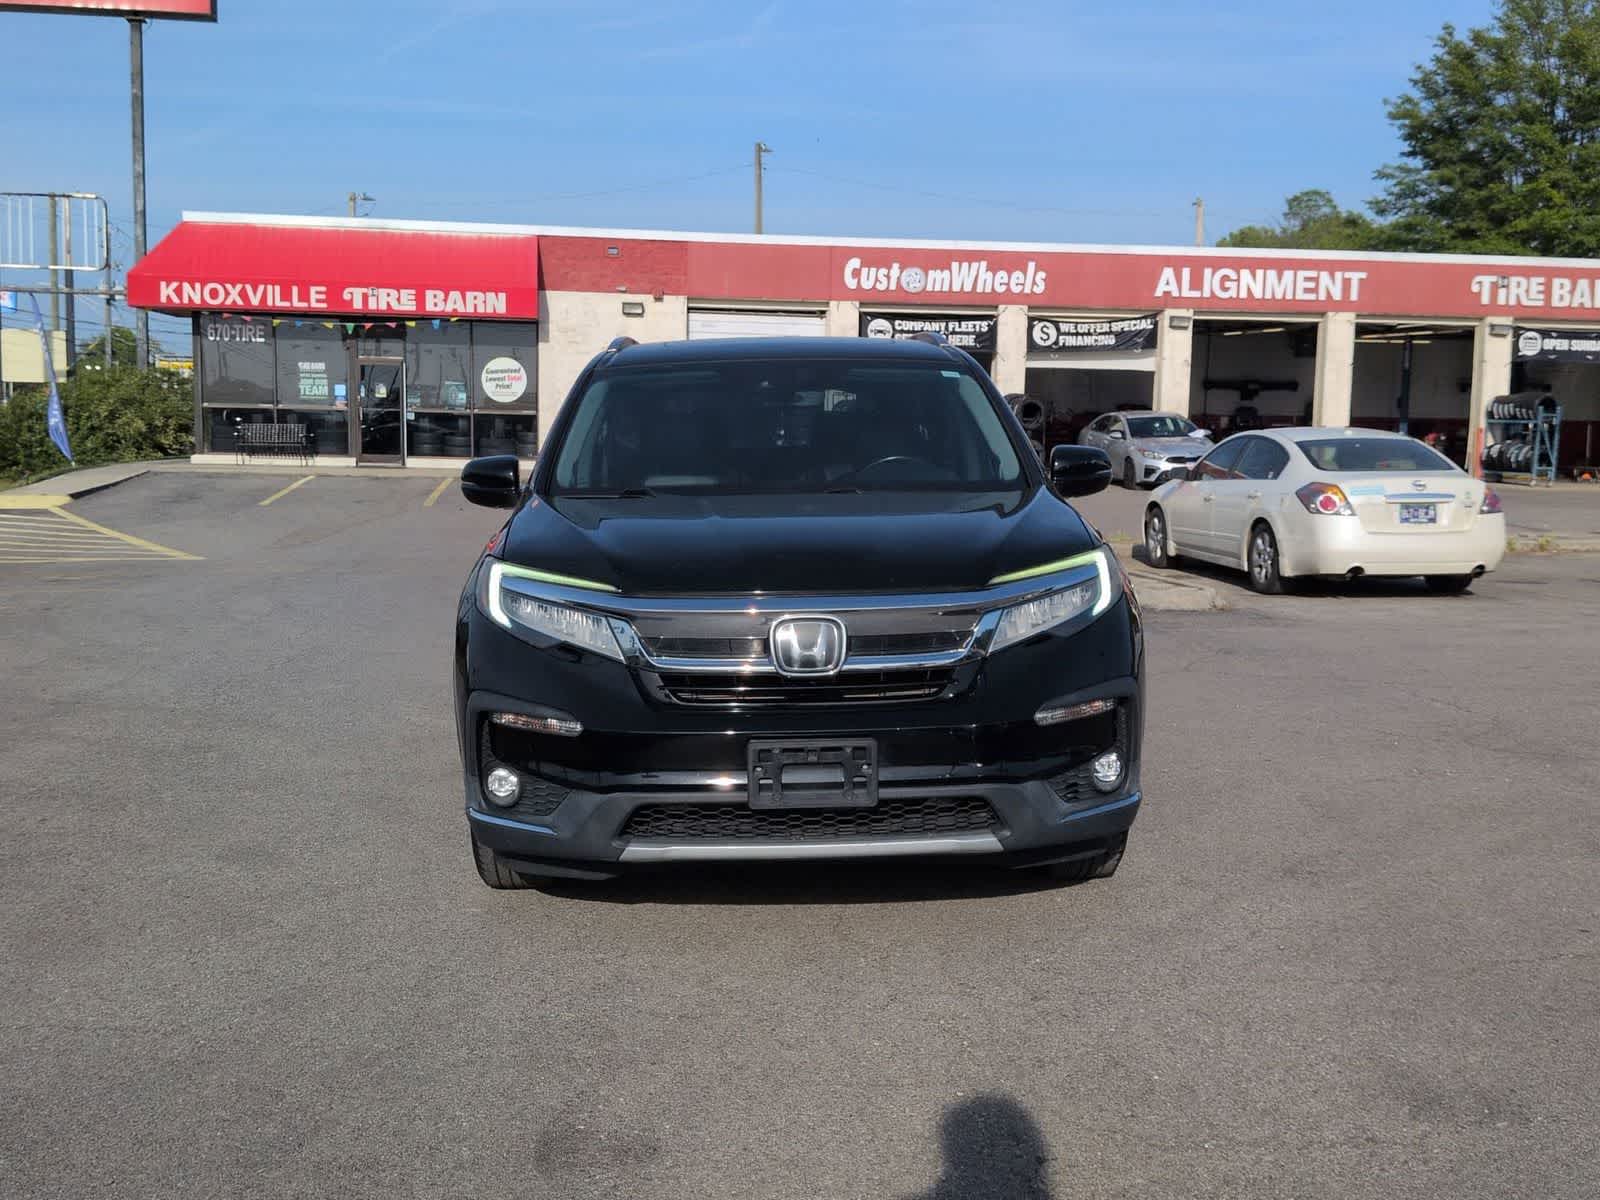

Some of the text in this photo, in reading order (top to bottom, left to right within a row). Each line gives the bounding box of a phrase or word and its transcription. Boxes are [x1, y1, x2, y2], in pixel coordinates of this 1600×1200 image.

[1154, 266, 1368, 301] ALIGNMENT
[159, 280, 328, 308] KNOXVILLE
[425, 289, 507, 313] BARN
[1551, 277, 1600, 309] BA
[894, 319, 989, 333] COMPANY FLEETS
[1059, 318, 1155, 334] WE OFFER SPECIAL
[948, 334, 977, 347] HERE
[1059, 334, 1116, 347] FINANCING
[299, 384, 329, 396] TEAM
